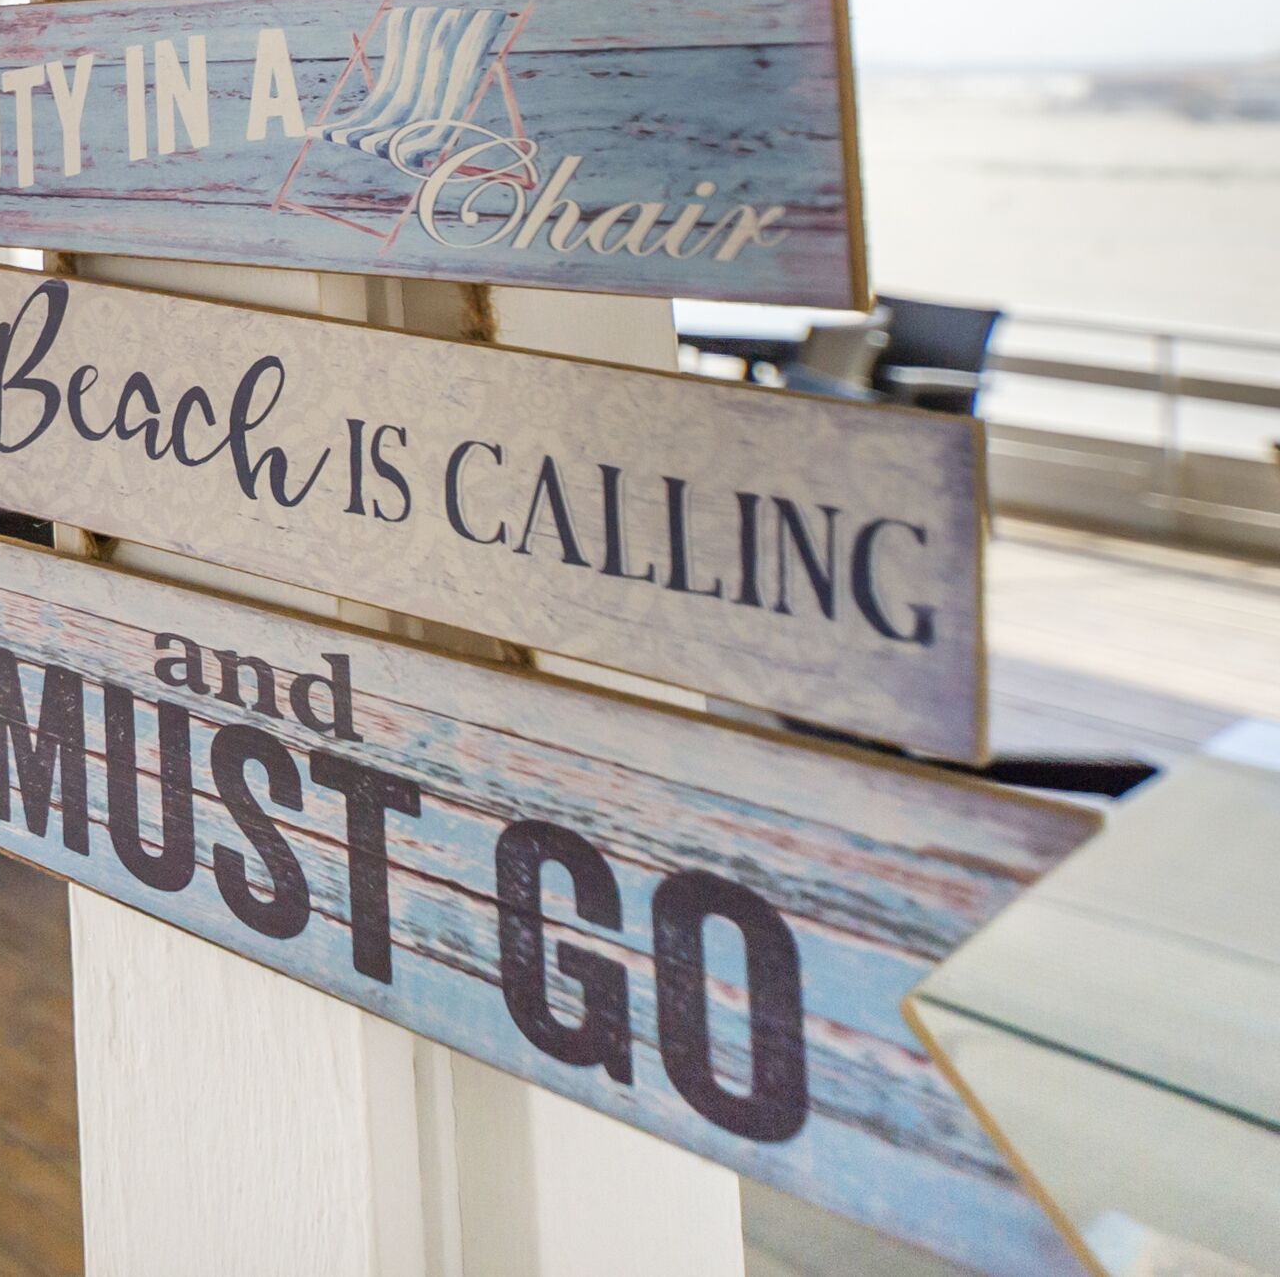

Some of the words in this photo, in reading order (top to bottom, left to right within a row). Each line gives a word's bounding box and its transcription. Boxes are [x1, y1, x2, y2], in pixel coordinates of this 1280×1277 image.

[126, 35, 210, 161] IN
[246, 27, 310, 141] A
[386, 118, 794, 265] Chair
[344, 417, 414, 524] IS
[444, 439, 940, 647] CALLING
[152, 629, 362, 743] and
[494, 817, 810, 1145] GO
